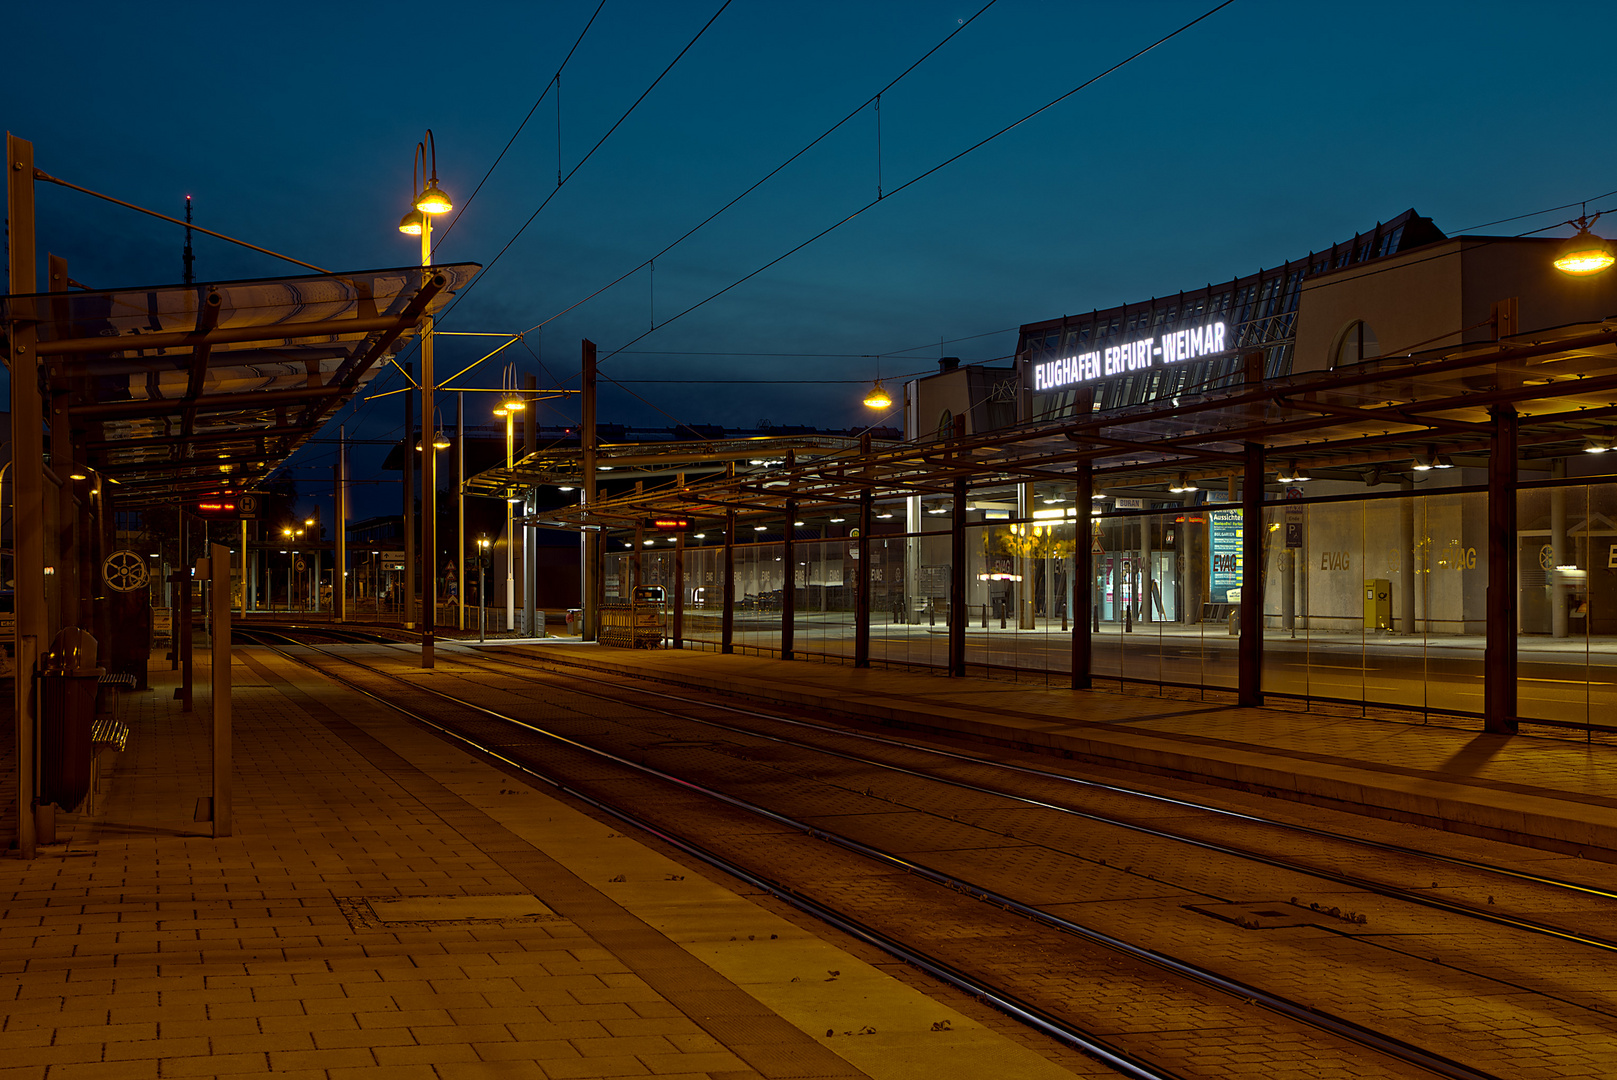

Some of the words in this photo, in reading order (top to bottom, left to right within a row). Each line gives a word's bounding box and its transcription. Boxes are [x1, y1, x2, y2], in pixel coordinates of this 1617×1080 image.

[1035, 350, 1101, 391] FLUGHAFEN
[1105, 321, 1226, 376] ERFURT-WEIMAR
[1213, 554, 1236, 571] EVAG
[1321, 551, 1350, 571] EVAG
[1440, 547, 1477, 571] EVAG
